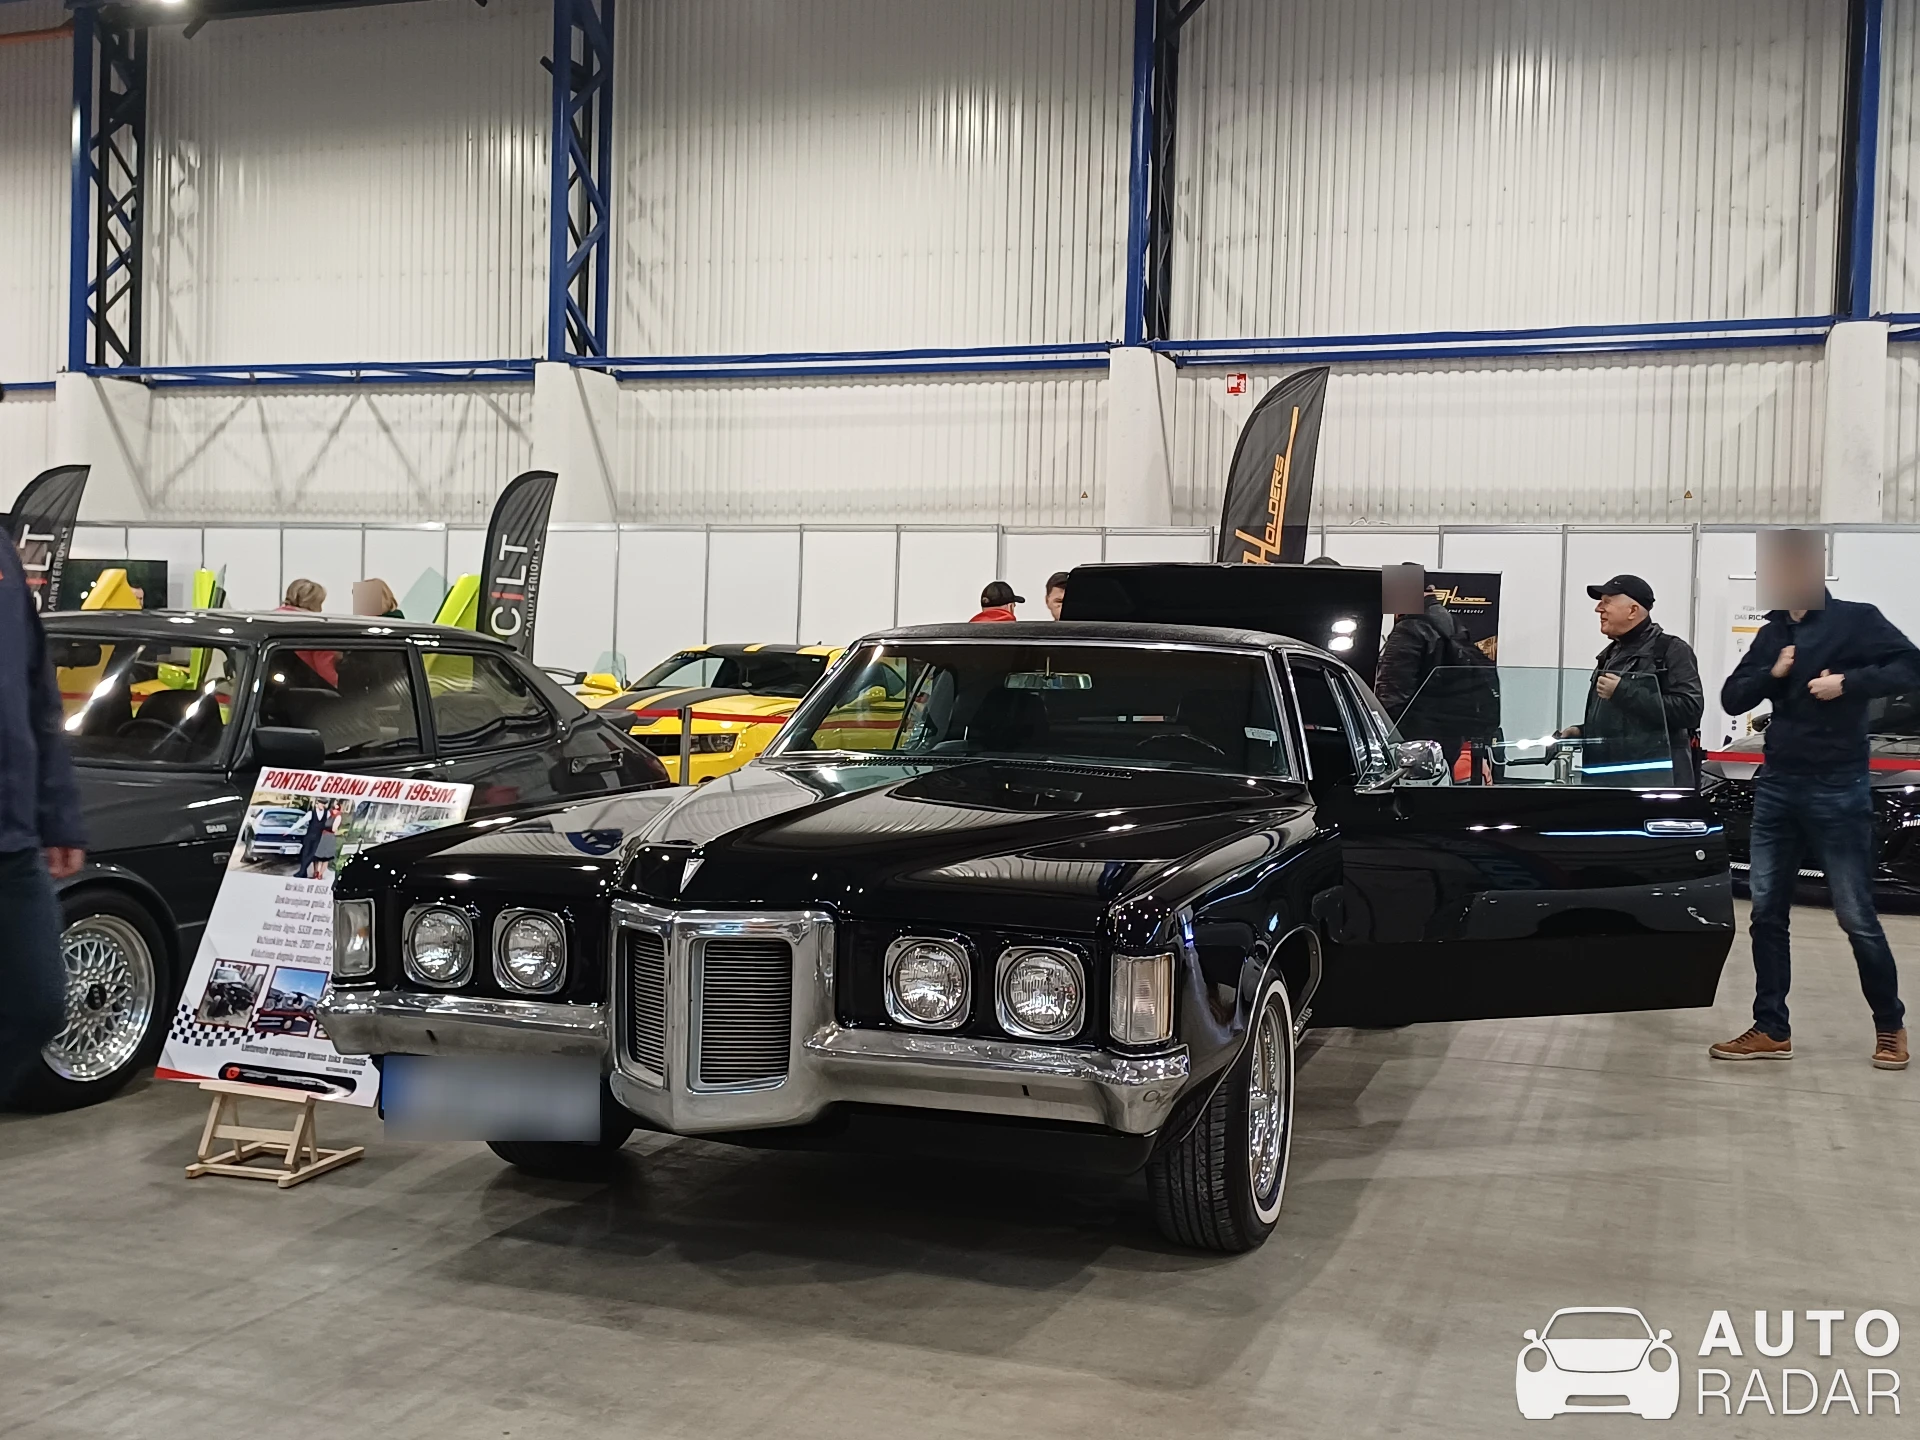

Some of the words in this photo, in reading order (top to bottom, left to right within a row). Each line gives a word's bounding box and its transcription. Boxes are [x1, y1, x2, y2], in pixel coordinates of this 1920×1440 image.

[1235, 420, 1297, 564] HOLDERS
[262, 771, 321, 792] PONTIAC
[321, 776, 368, 796] GRAND
[368, 782, 404, 799] PRIX
